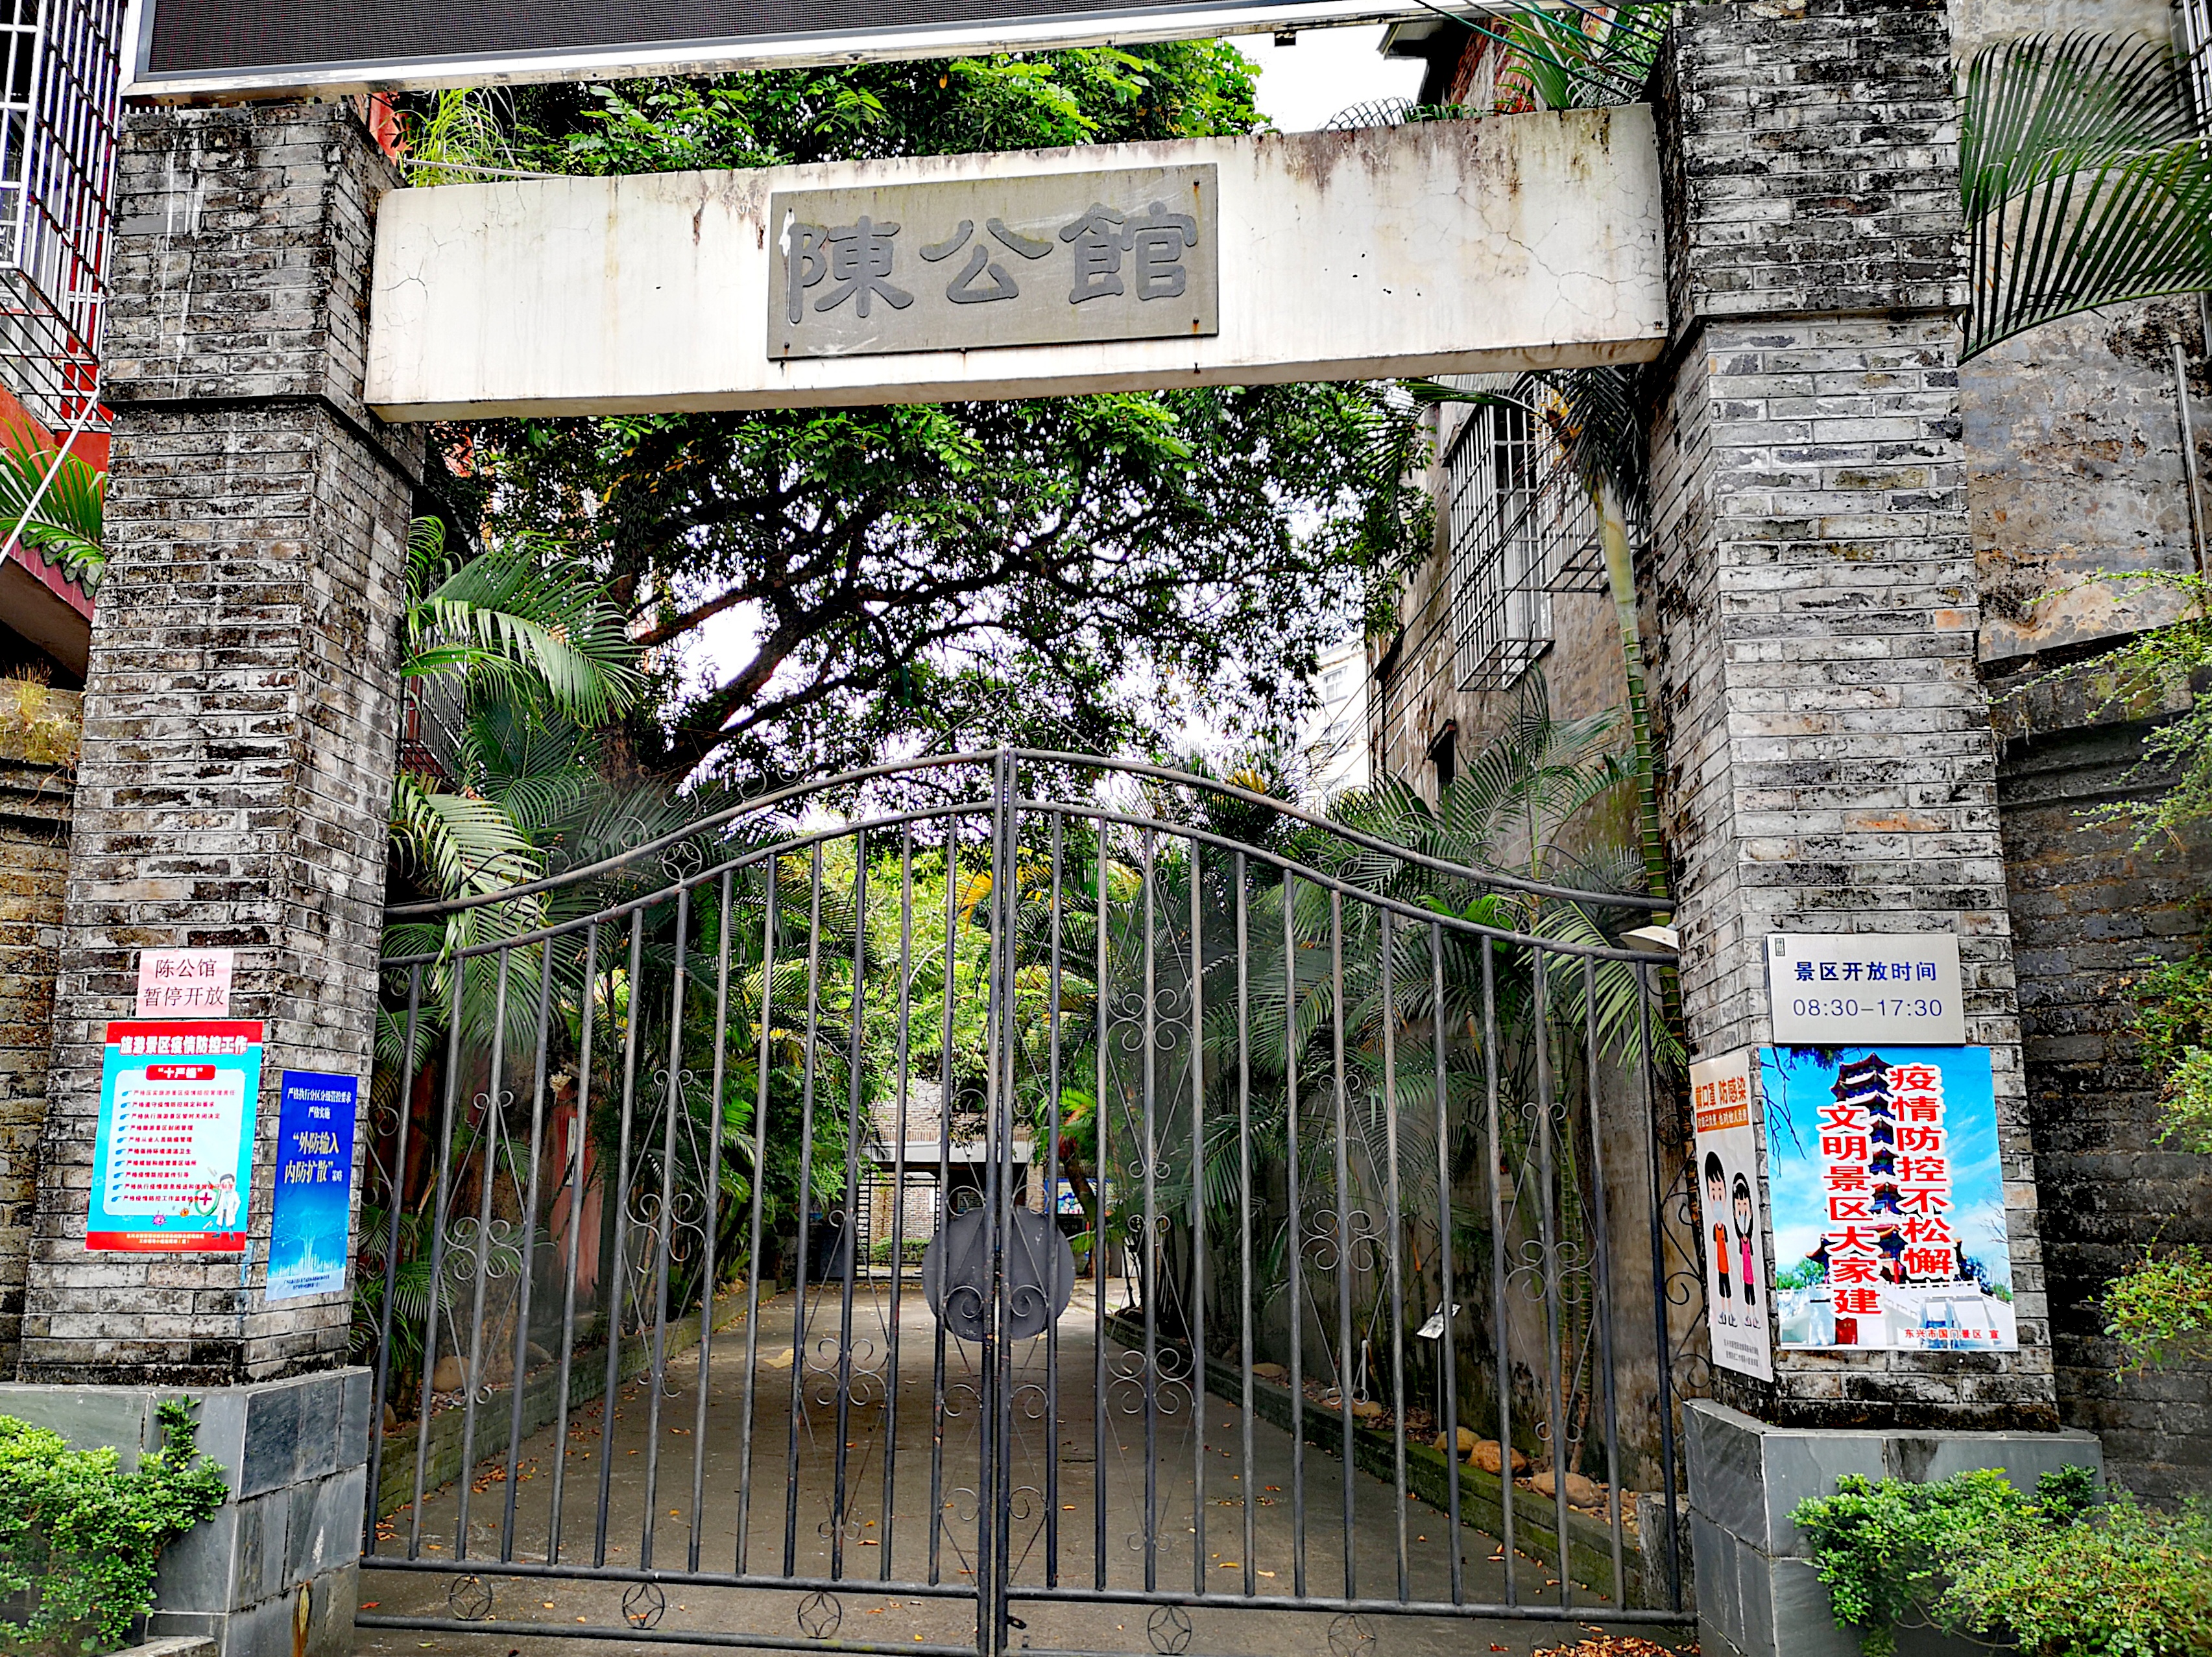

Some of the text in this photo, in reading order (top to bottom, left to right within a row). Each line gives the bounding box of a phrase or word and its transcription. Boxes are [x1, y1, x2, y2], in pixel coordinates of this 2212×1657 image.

[787, 201, 1199, 324] 陳公館
[155, 958, 217, 979] 陈公馆
[1794, 961, 1937, 982] 景区开放时间
[143, 986, 225, 1007] 暂停开放
[1793, 999, 1943, 1017] 08:30-17:30
[120, 1034, 248, 1055] 旅游景区疫情防控工作
[287, 1087, 352, 1104] 严格执行分区分级管控要求
[1695, 1075, 1746, 1110] 戴口罩 防感染
[307, 1106, 331, 1120] 严格实施
[1889, 1066, 1954, 1274] 疫情防控不松懈
[1819, 1104, 1882, 1315] 文明景区大家建
[1904, 1328, 2000, 1339] 东兴市国门景区 宣
